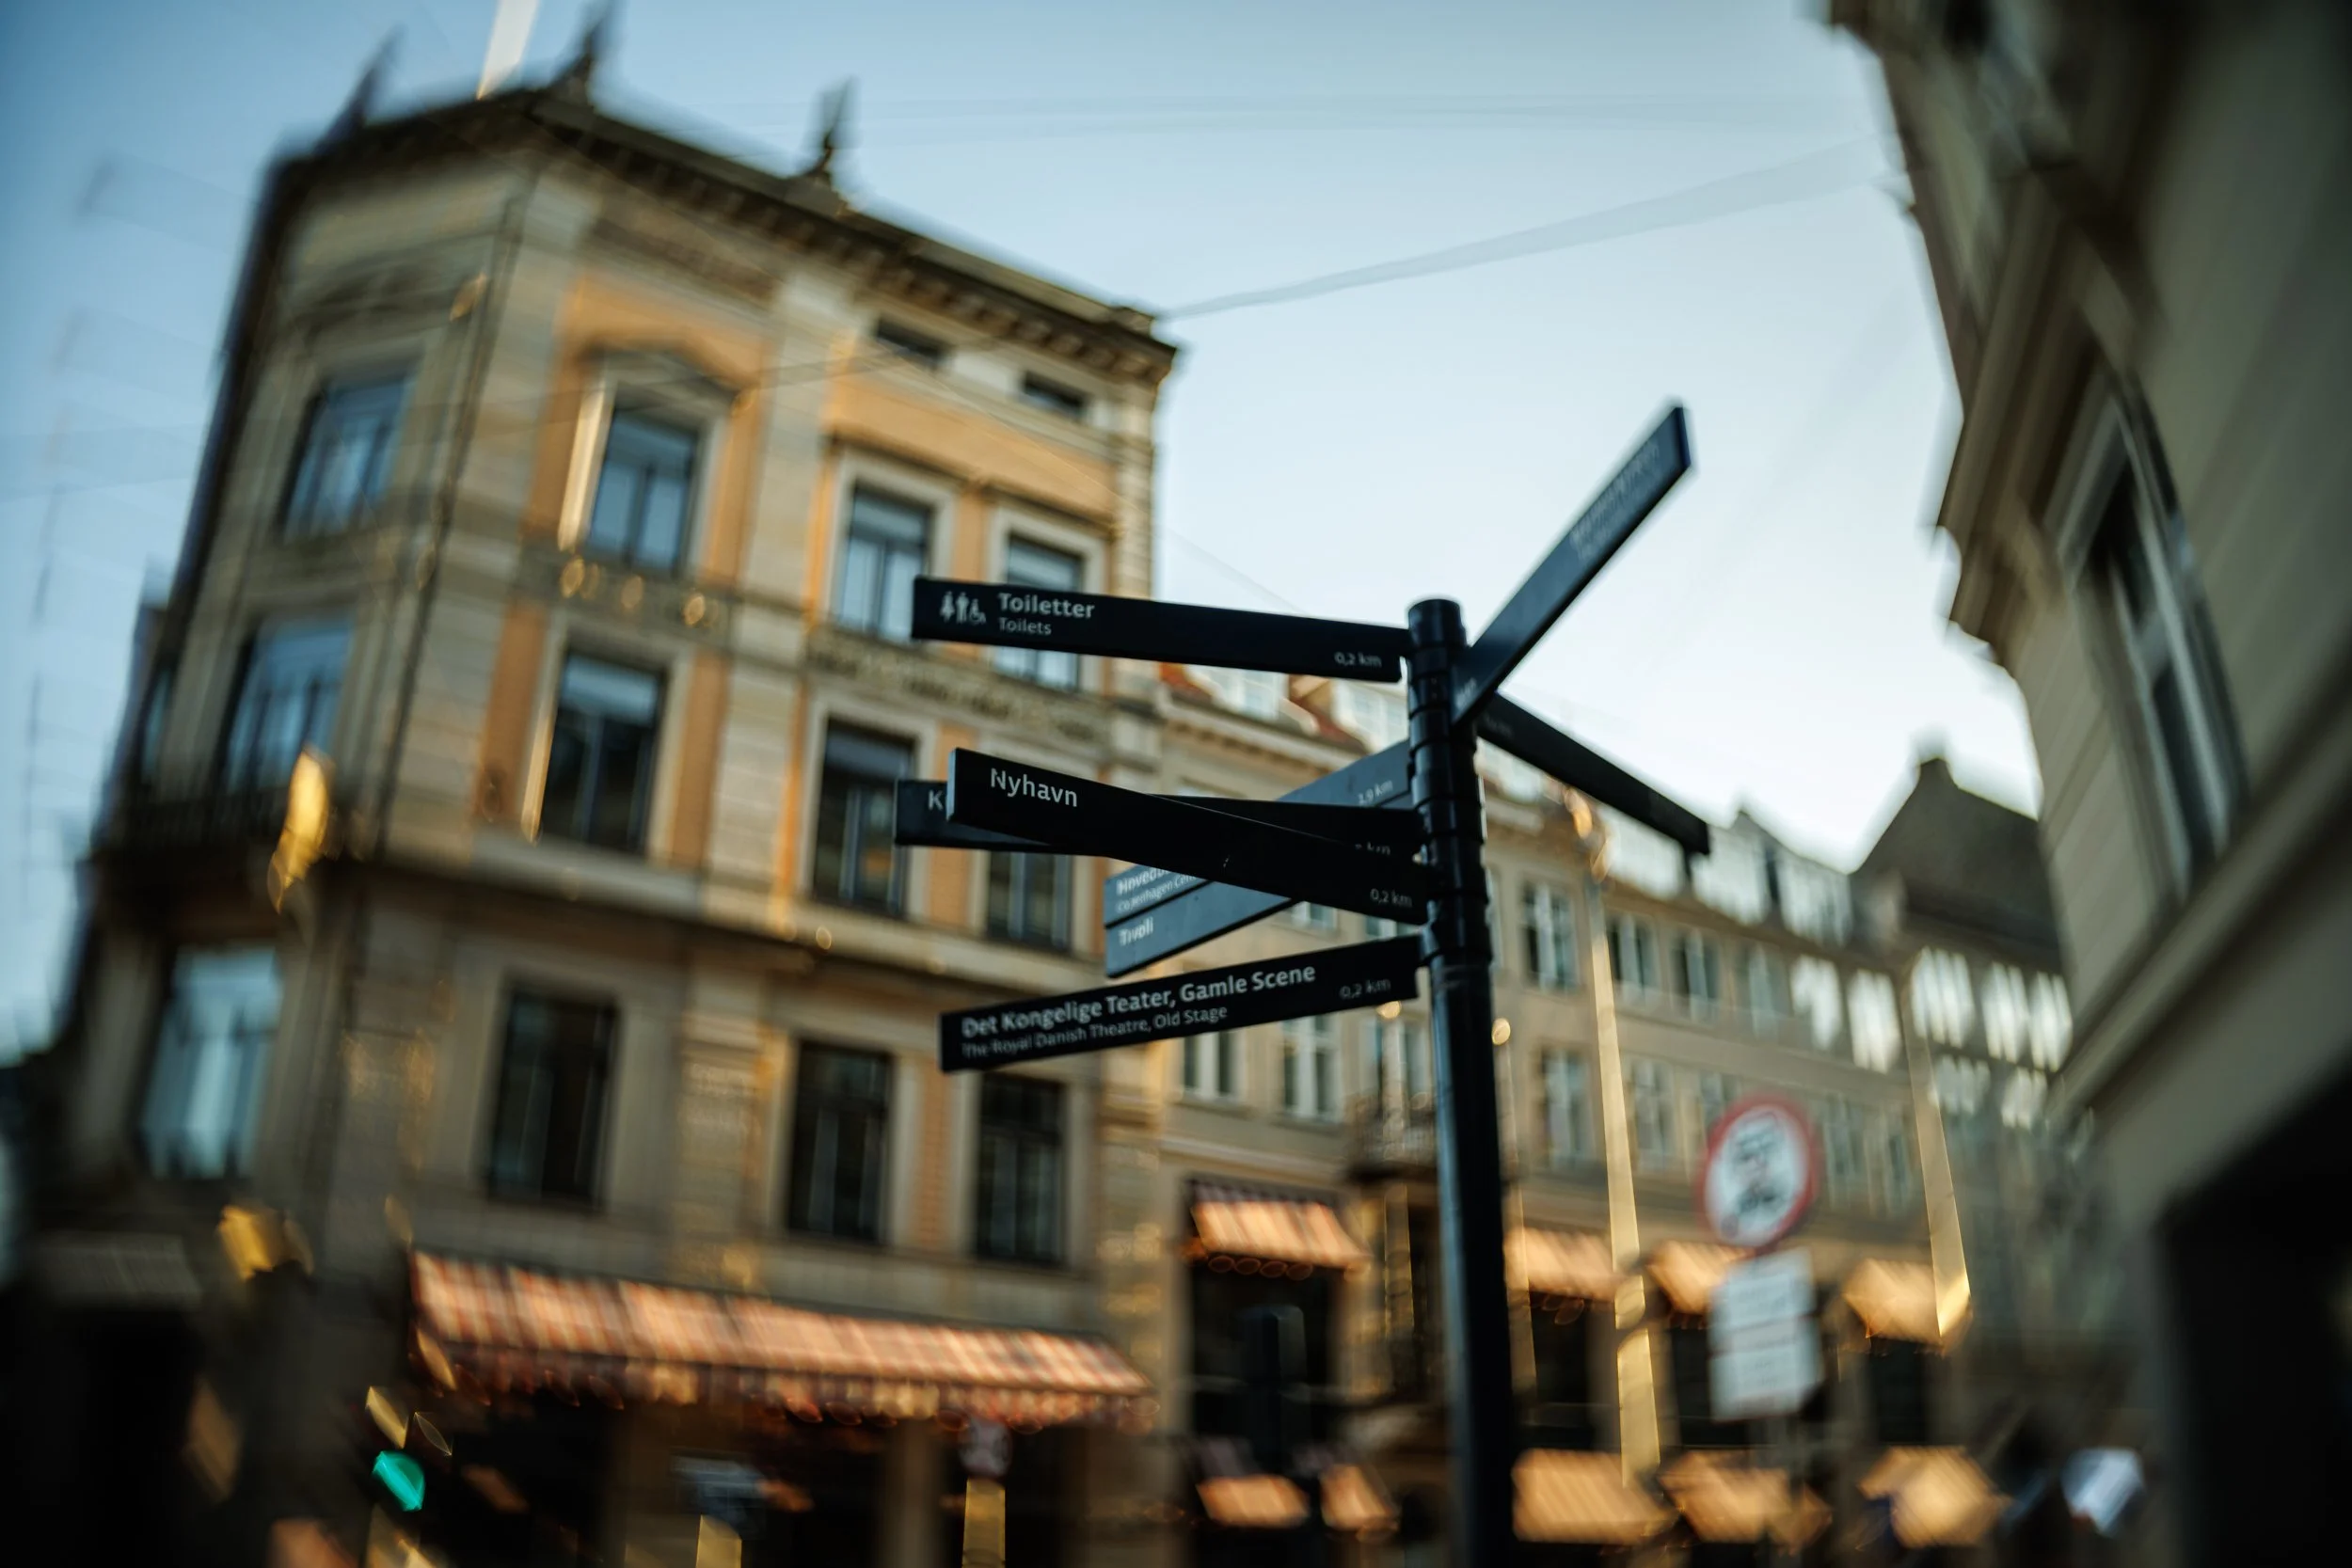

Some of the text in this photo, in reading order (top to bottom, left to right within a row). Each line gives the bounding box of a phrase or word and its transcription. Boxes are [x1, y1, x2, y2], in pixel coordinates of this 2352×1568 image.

[998, 592, 1094, 618] Toiletter
[998, 617, 1052, 635] Toilets
[1358, 651, 1382, 668] km
[991, 768, 1077, 807] Nyhavn
[1370, 888, 1412, 909] 0,2 km
[1119, 916, 1153, 946] Tivoli
[961, 966, 1315, 1038] Det Kongelige Teater, Gamle Scene
[1340, 979, 1391, 999] 0,2 km
[961, 1006, 1228, 1058] The Royal Danish Theatre, Old Stage
